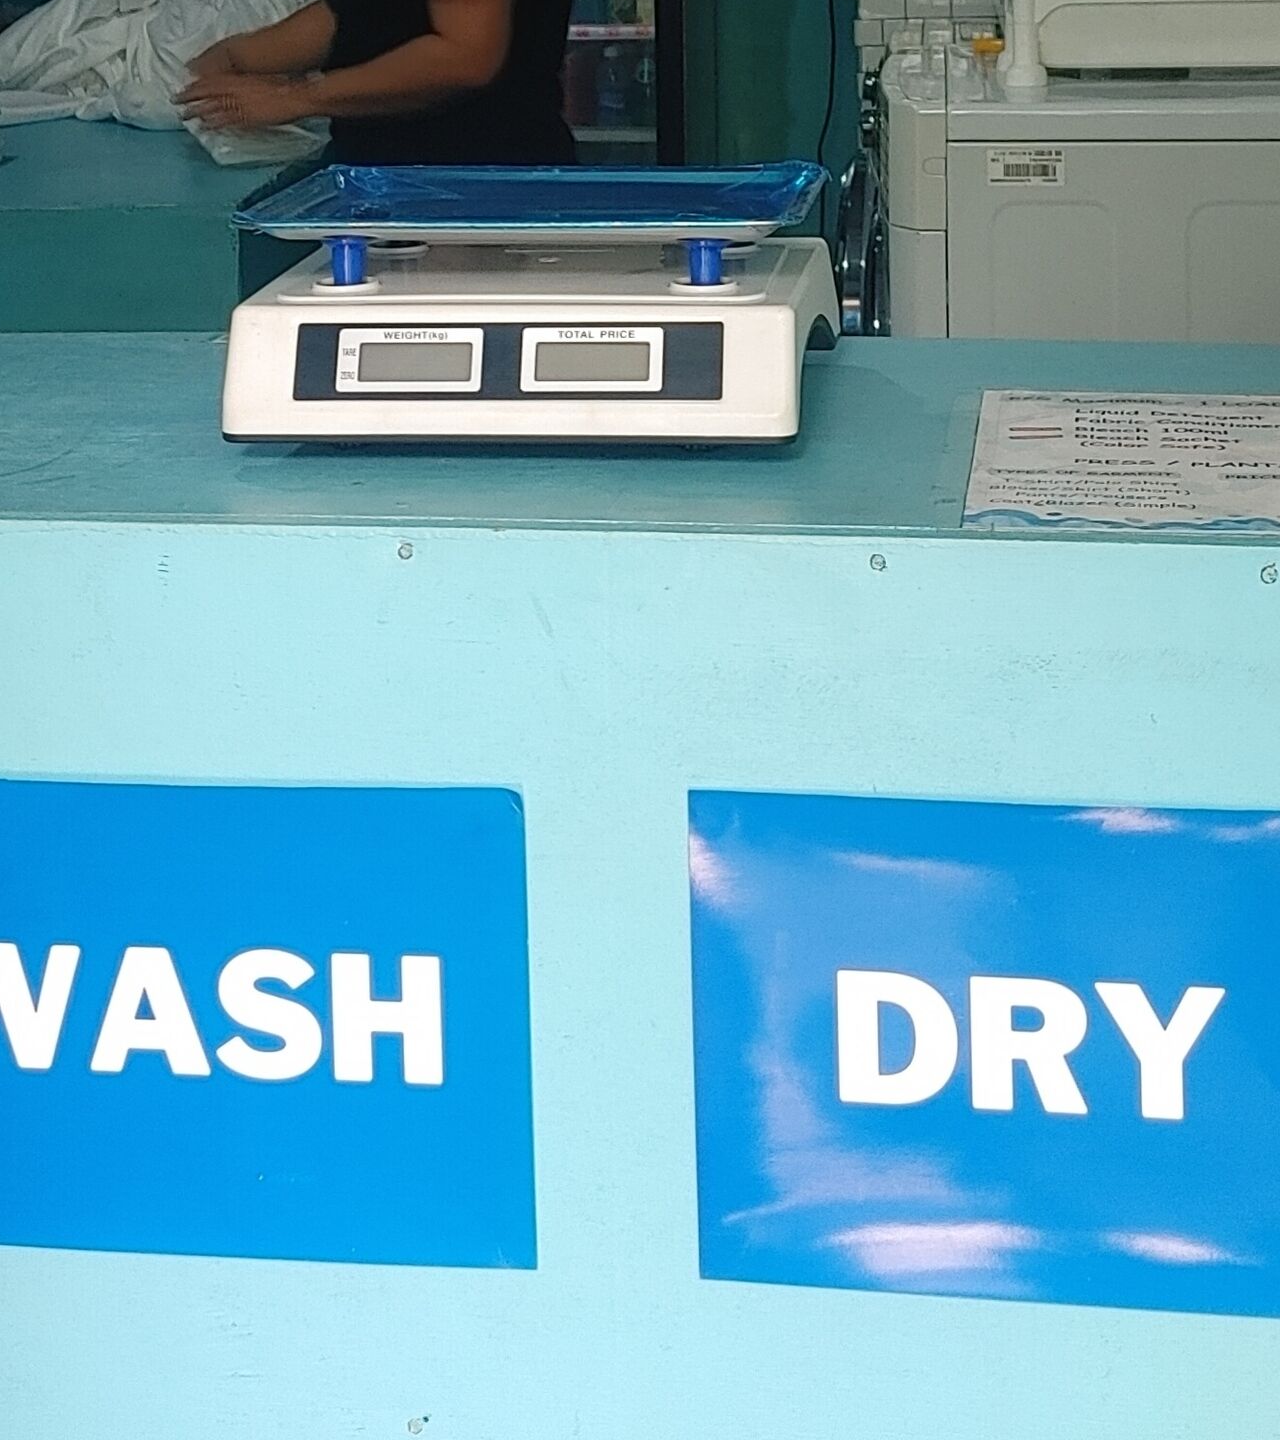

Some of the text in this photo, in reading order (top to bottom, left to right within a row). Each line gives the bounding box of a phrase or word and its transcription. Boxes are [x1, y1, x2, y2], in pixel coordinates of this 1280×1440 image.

[384, 330, 448, 340] WEIGHT(kg)
[558, 330, 635, 339] TOTAL PRICE
[342, 347, 357, 357] TARE
[1151, 411, 1265, 421] Detergent
[1074, 417, 1146, 425] Fabric
[1161, 427, 1229, 436] 100ml
[1160, 436, 1242, 444] Sachet
[1160, 443, 1227, 451] Safe)
[1074, 458, 1156, 466] PRESS
[1118, 487, 1191, 496] (Short)
[1114, 501, 1197, 510] (Simple)
[836, 968, 1226, 1121] DRY
